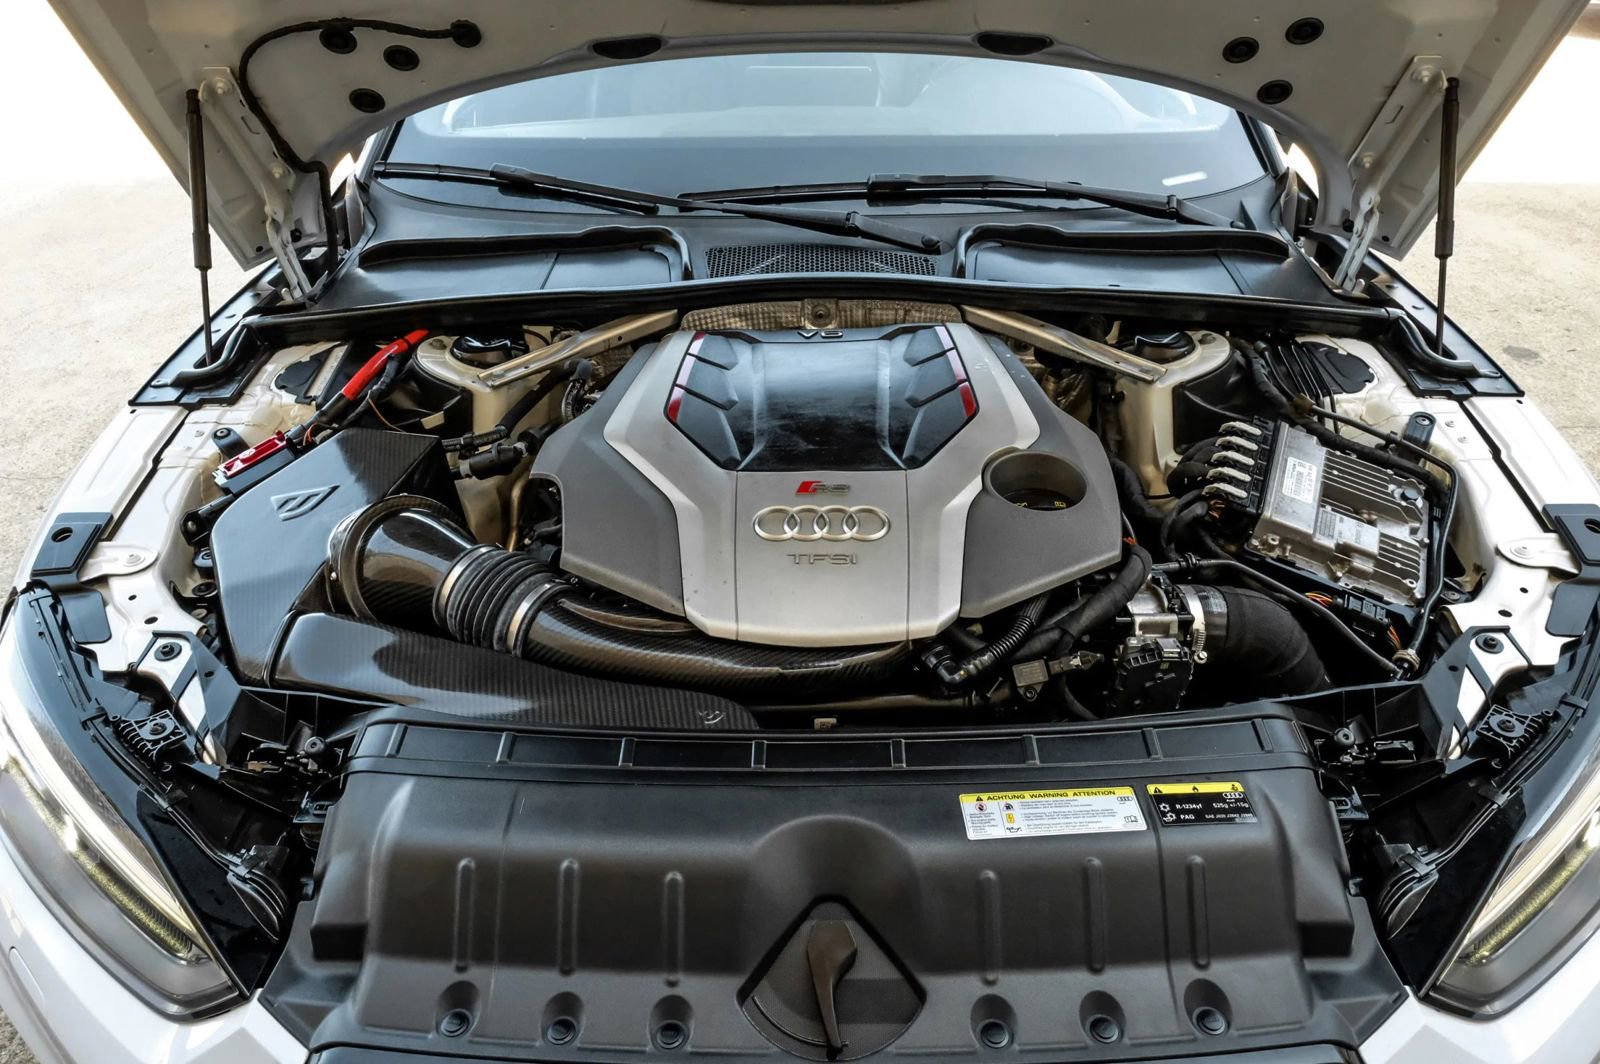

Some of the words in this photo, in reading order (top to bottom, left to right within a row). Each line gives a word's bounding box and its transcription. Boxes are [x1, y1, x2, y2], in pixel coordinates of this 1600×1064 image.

[787, 553, 858, 565] TFSI
[986, 793, 1026, 801] ACHTUNG
[1028, 791, 1069, 799] WARNING
